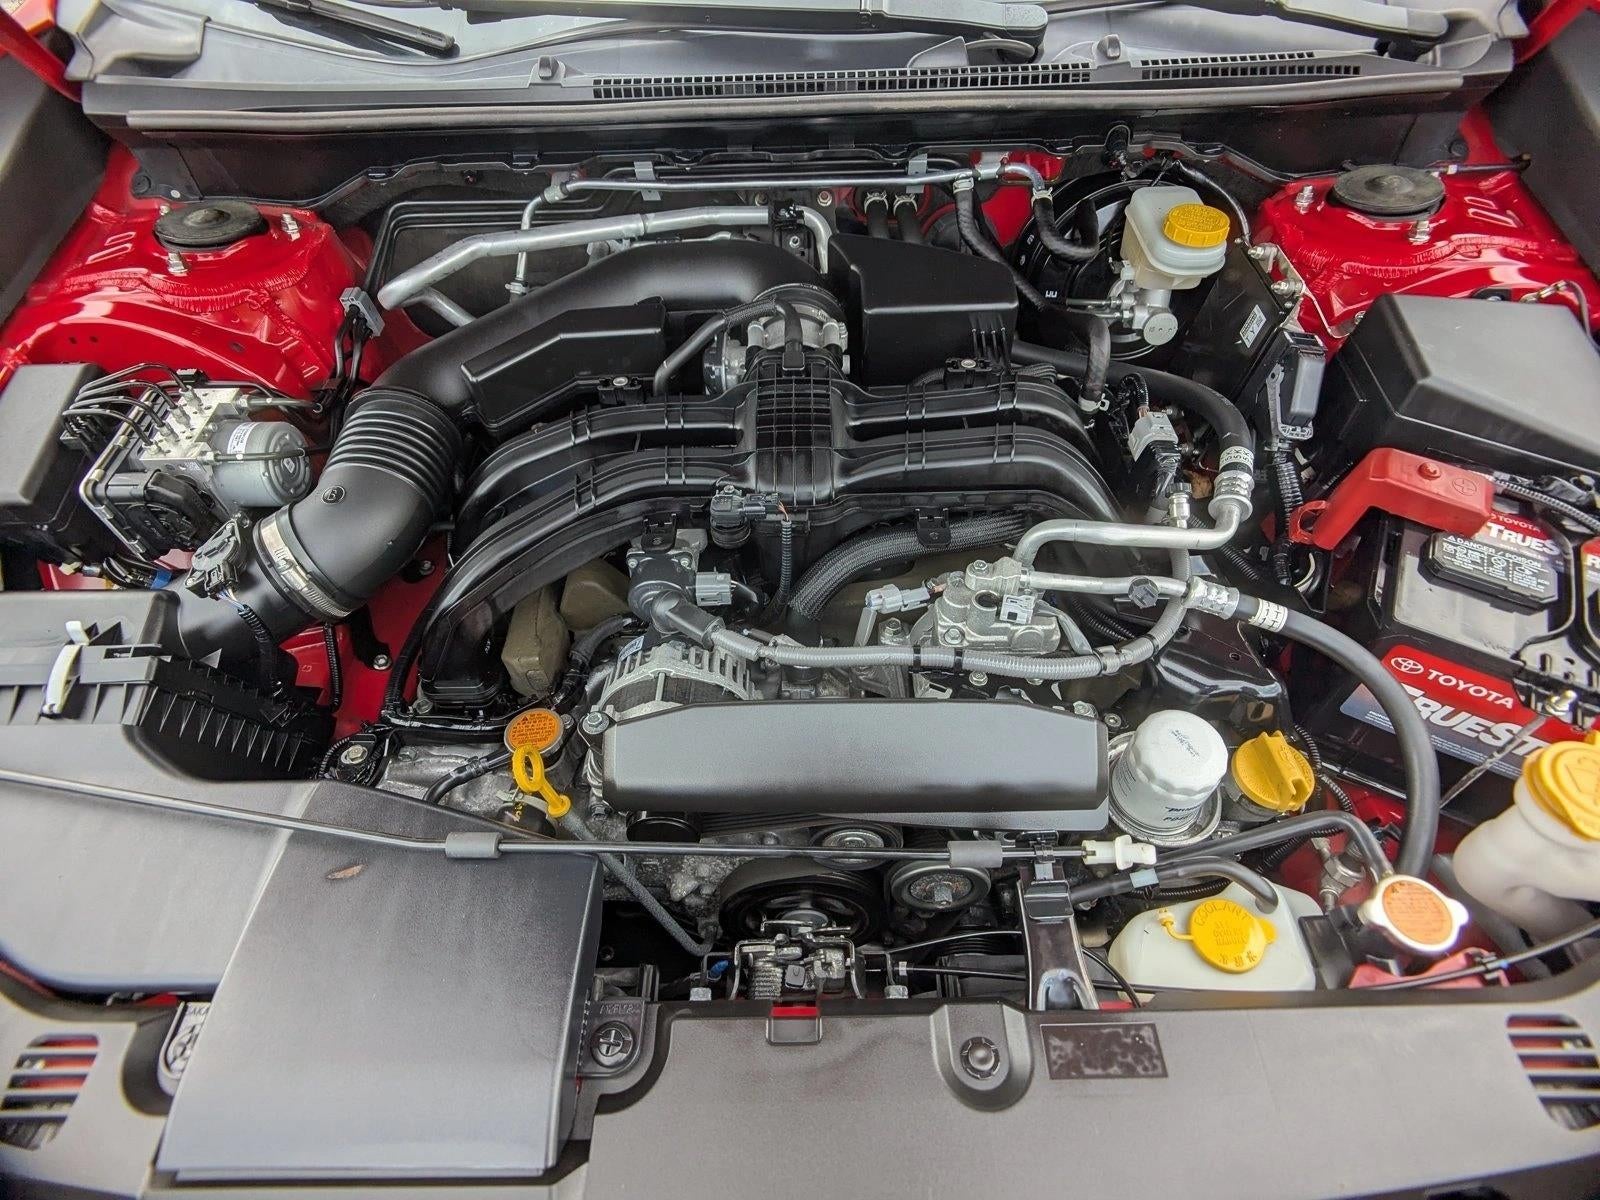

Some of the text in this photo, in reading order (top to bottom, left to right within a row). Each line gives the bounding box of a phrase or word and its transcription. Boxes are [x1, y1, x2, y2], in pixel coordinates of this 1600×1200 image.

[1498, 515, 1541, 532] TOYOTA
[1455, 537, 1496, 555] DANGER
[1505, 553, 1542, 568] POISON
[1427, 668, 1514, 710] TOYOTA
[1194, 902, 1253, 926] COOLANT
